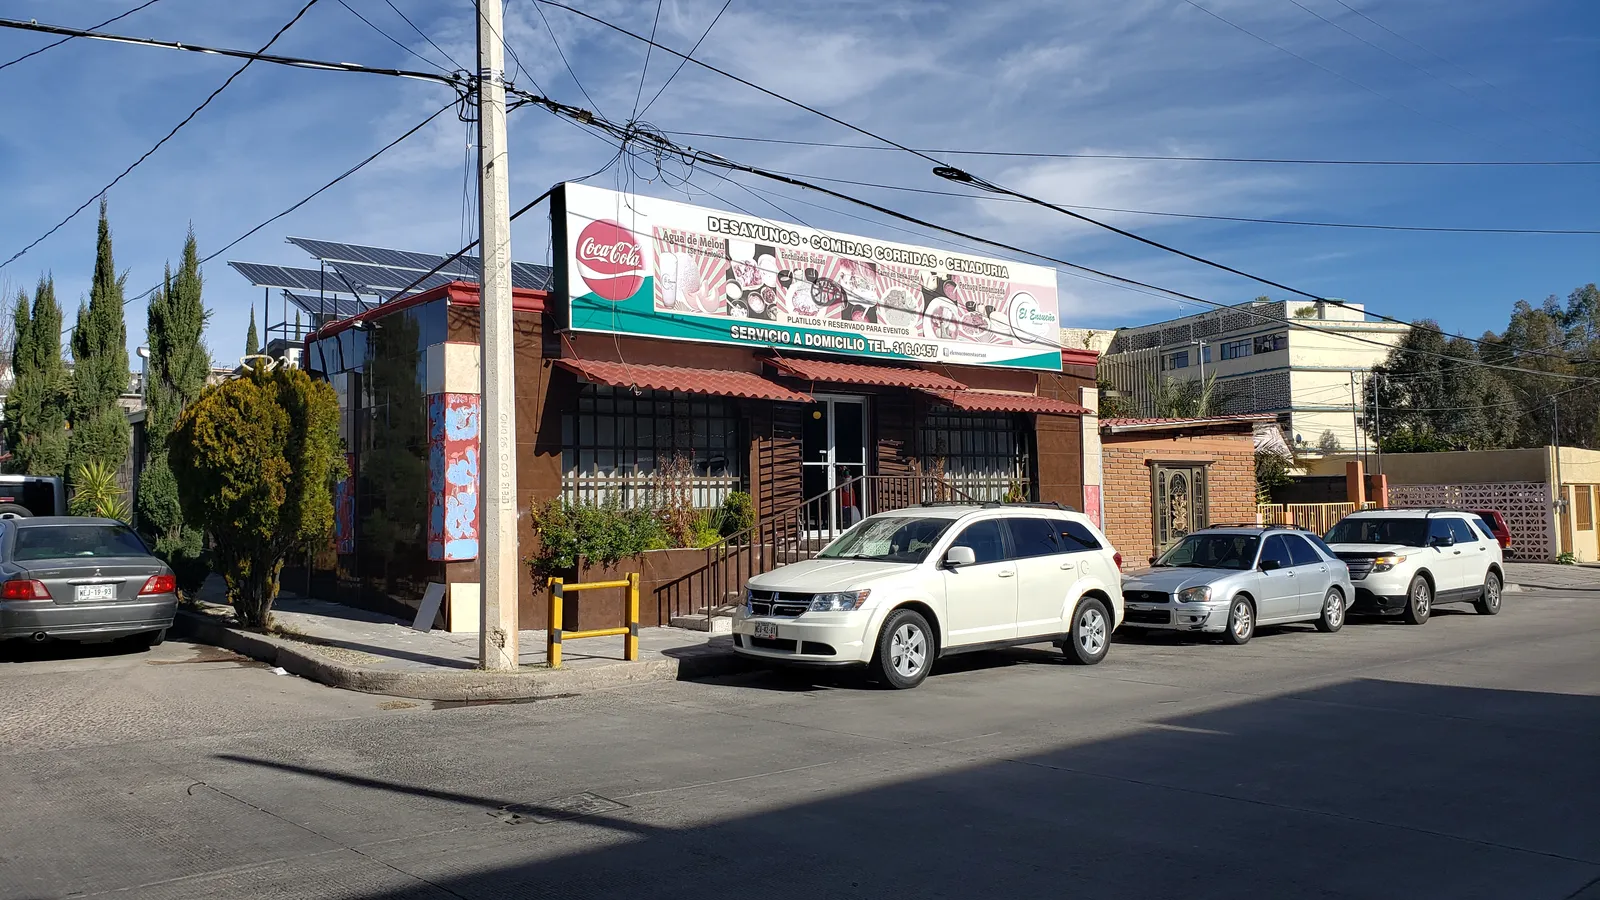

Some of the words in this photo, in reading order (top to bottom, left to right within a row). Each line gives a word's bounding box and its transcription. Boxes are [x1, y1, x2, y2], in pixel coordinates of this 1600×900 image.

[663, 231, 685, 244] Agua
[687, 234, 698, 245] de
[708, 216, 800, 246] DESAYUNOS
[810, 235, 872, 259] COMIDAS
[874, 246, 937, 268] CORRIDAS
[945, 257, 1010, 278] CENADURIA
[580, 237, 642, 266] Coca-Cola
[782, 252, 809, 262] Enchiladas
[810, 256, 826, 265] Suizas
[1018, 308, 1028, 319] El
[787, 316, 820, 326] PLATILLOS
[828, 320, 865, 331] RESERVADO
[883, 327, 910, 335] EVENTOS
[730, 325, 790, 344] SERVICIO
[794, 332, 802, 344] A
[805, 334, 864, 351] DOMICILIO
[868, 340, 891, 353] TEL.
[892, 341, 938, 357] 316.0457
